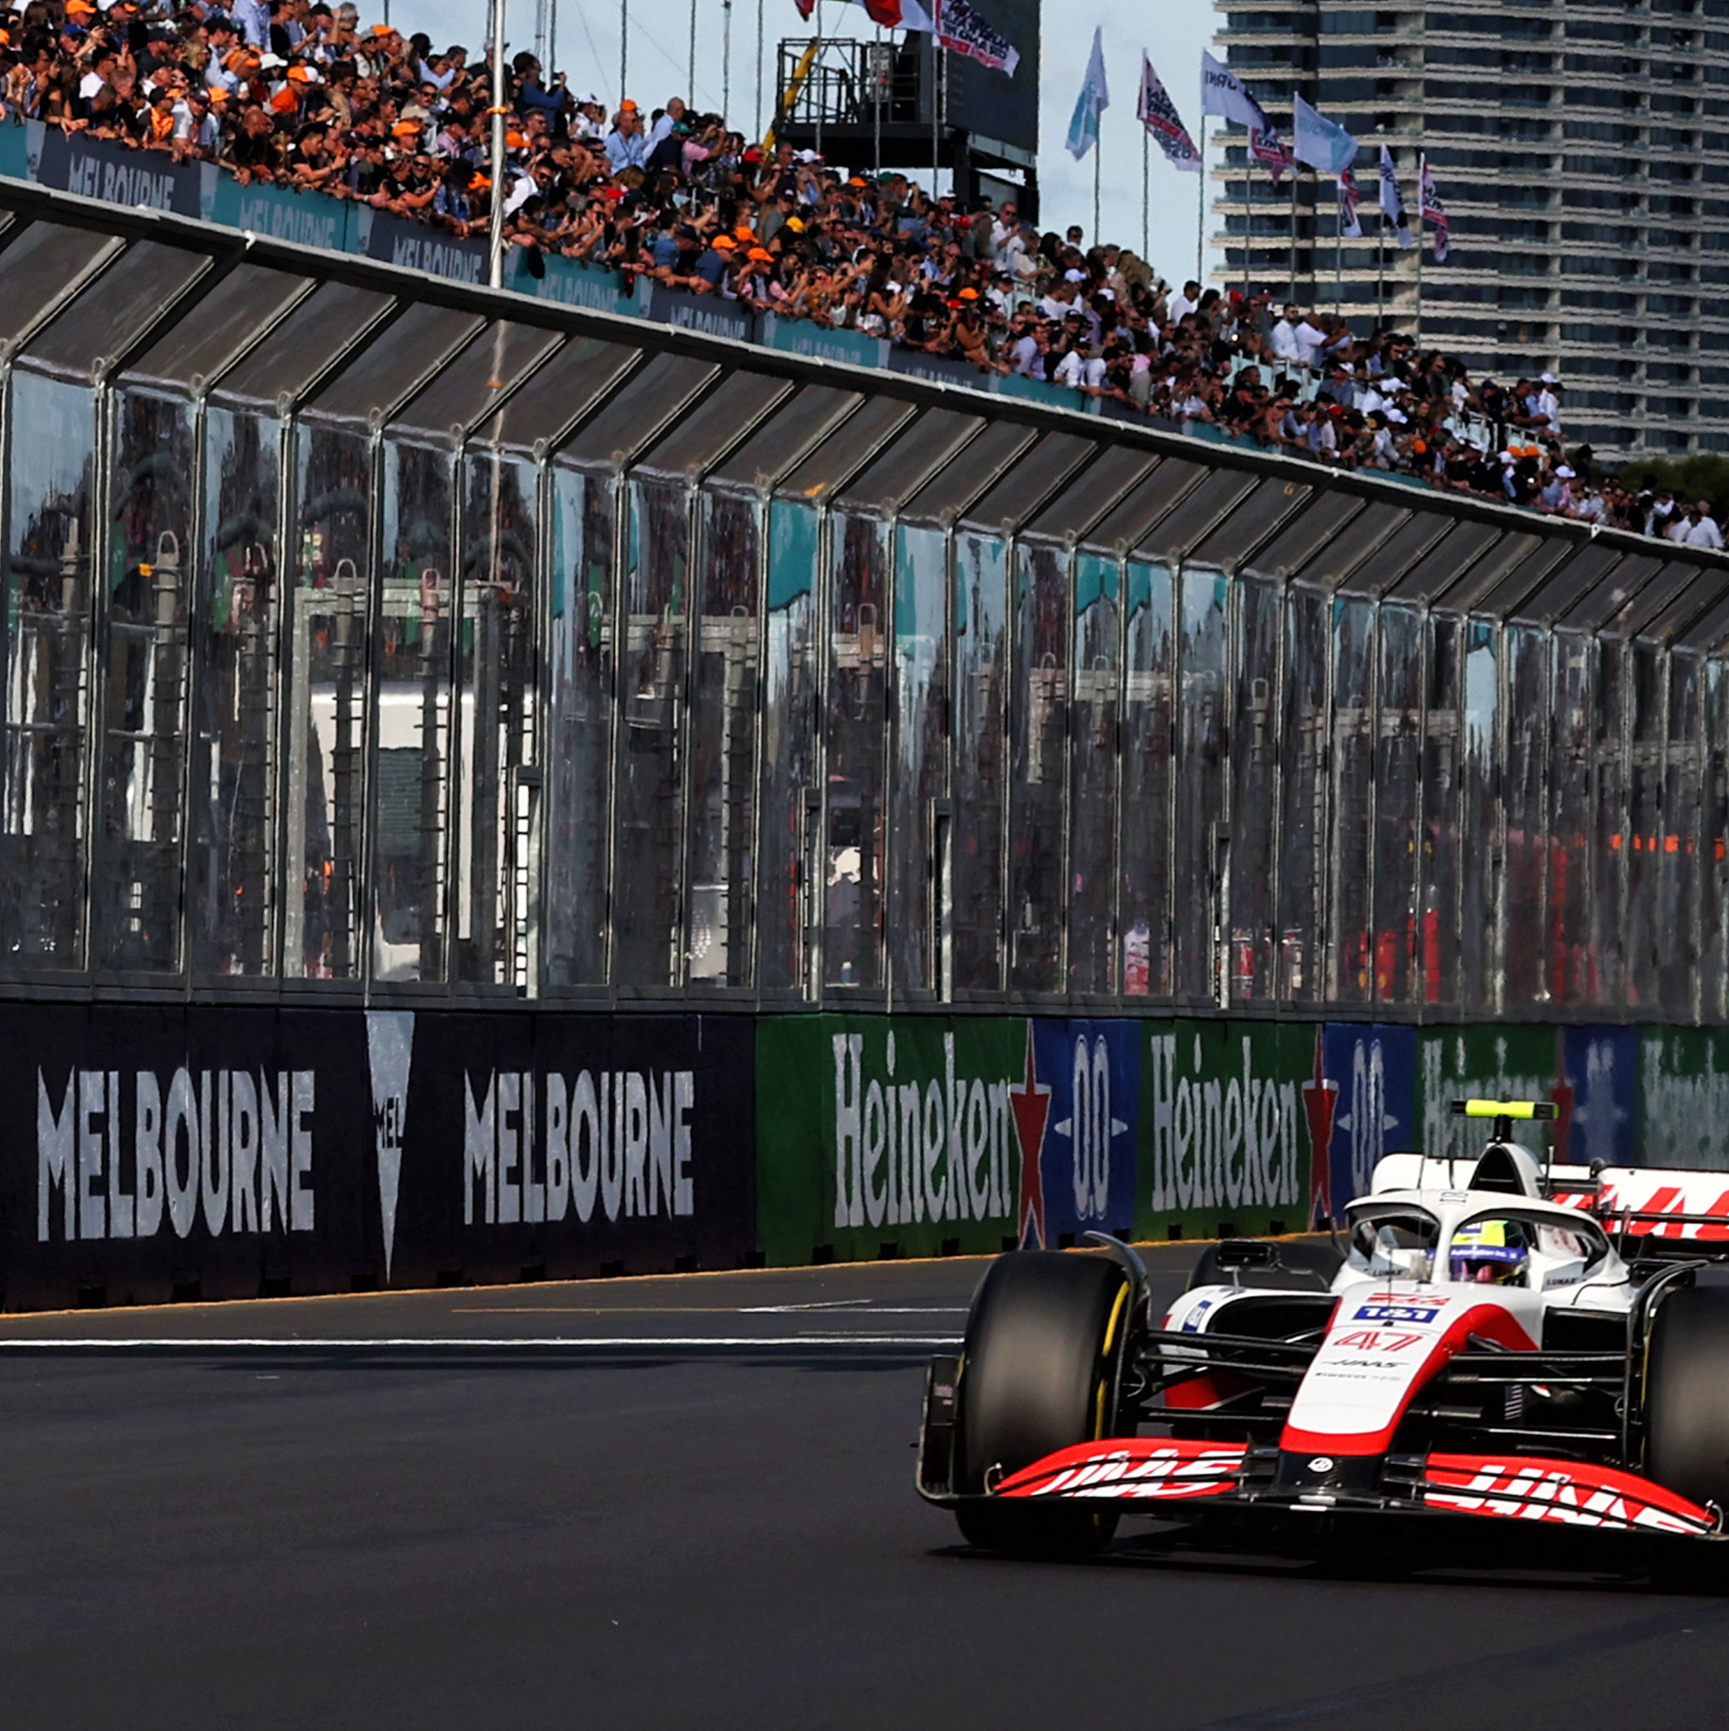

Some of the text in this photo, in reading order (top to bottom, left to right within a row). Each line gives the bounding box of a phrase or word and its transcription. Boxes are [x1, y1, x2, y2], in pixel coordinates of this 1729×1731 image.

[37, 1063, 316, 1243] MELBOURNE
[374, 1095, 404, 1150] MEL
[464, 1067, 694, 1225] MELBOURNE
[833, 1030, 1012, 1228] Heineken
[1150, 1032, 1299, 1212] Heineken
[1333, 1330, 1424, 1352] 47
